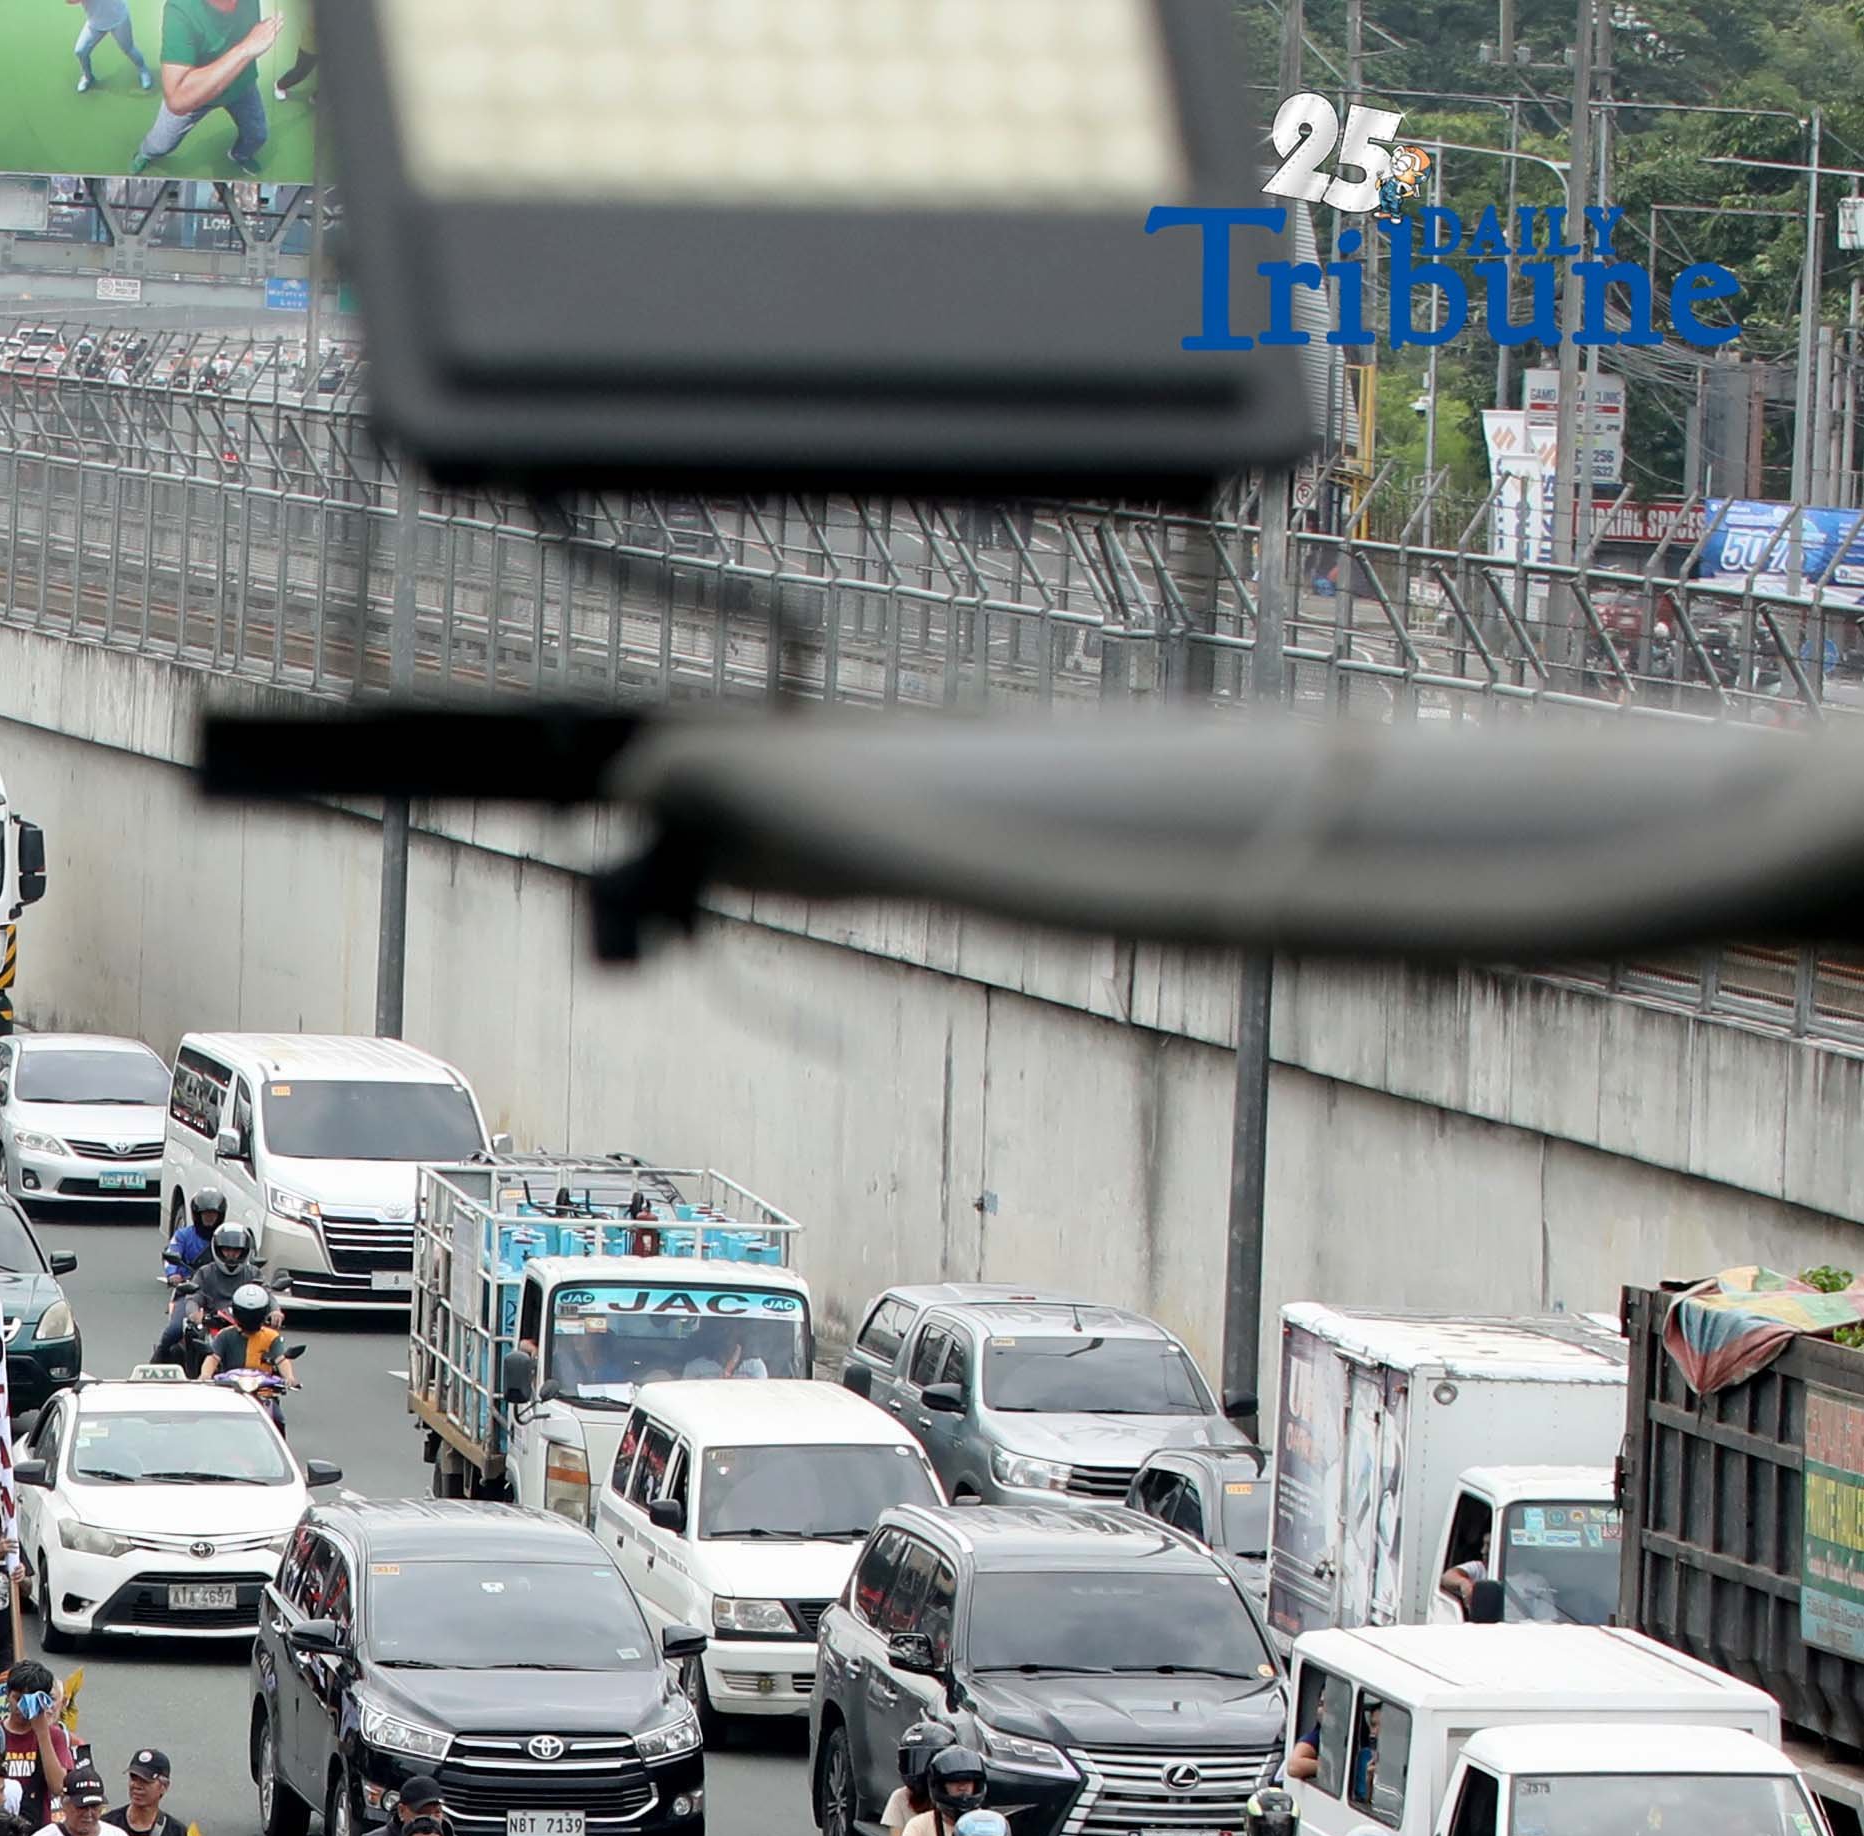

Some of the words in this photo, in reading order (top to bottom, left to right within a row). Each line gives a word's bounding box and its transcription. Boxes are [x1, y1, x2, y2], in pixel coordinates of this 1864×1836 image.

[609, 1292, 749, 1316] JAC
[764, 1298, 793, 1310] JAC
[139, 1365, 178, 1380] TAXI
[510, 1817, 537, 1833] NBT
[544, 1817, 584, 1832] 7139
